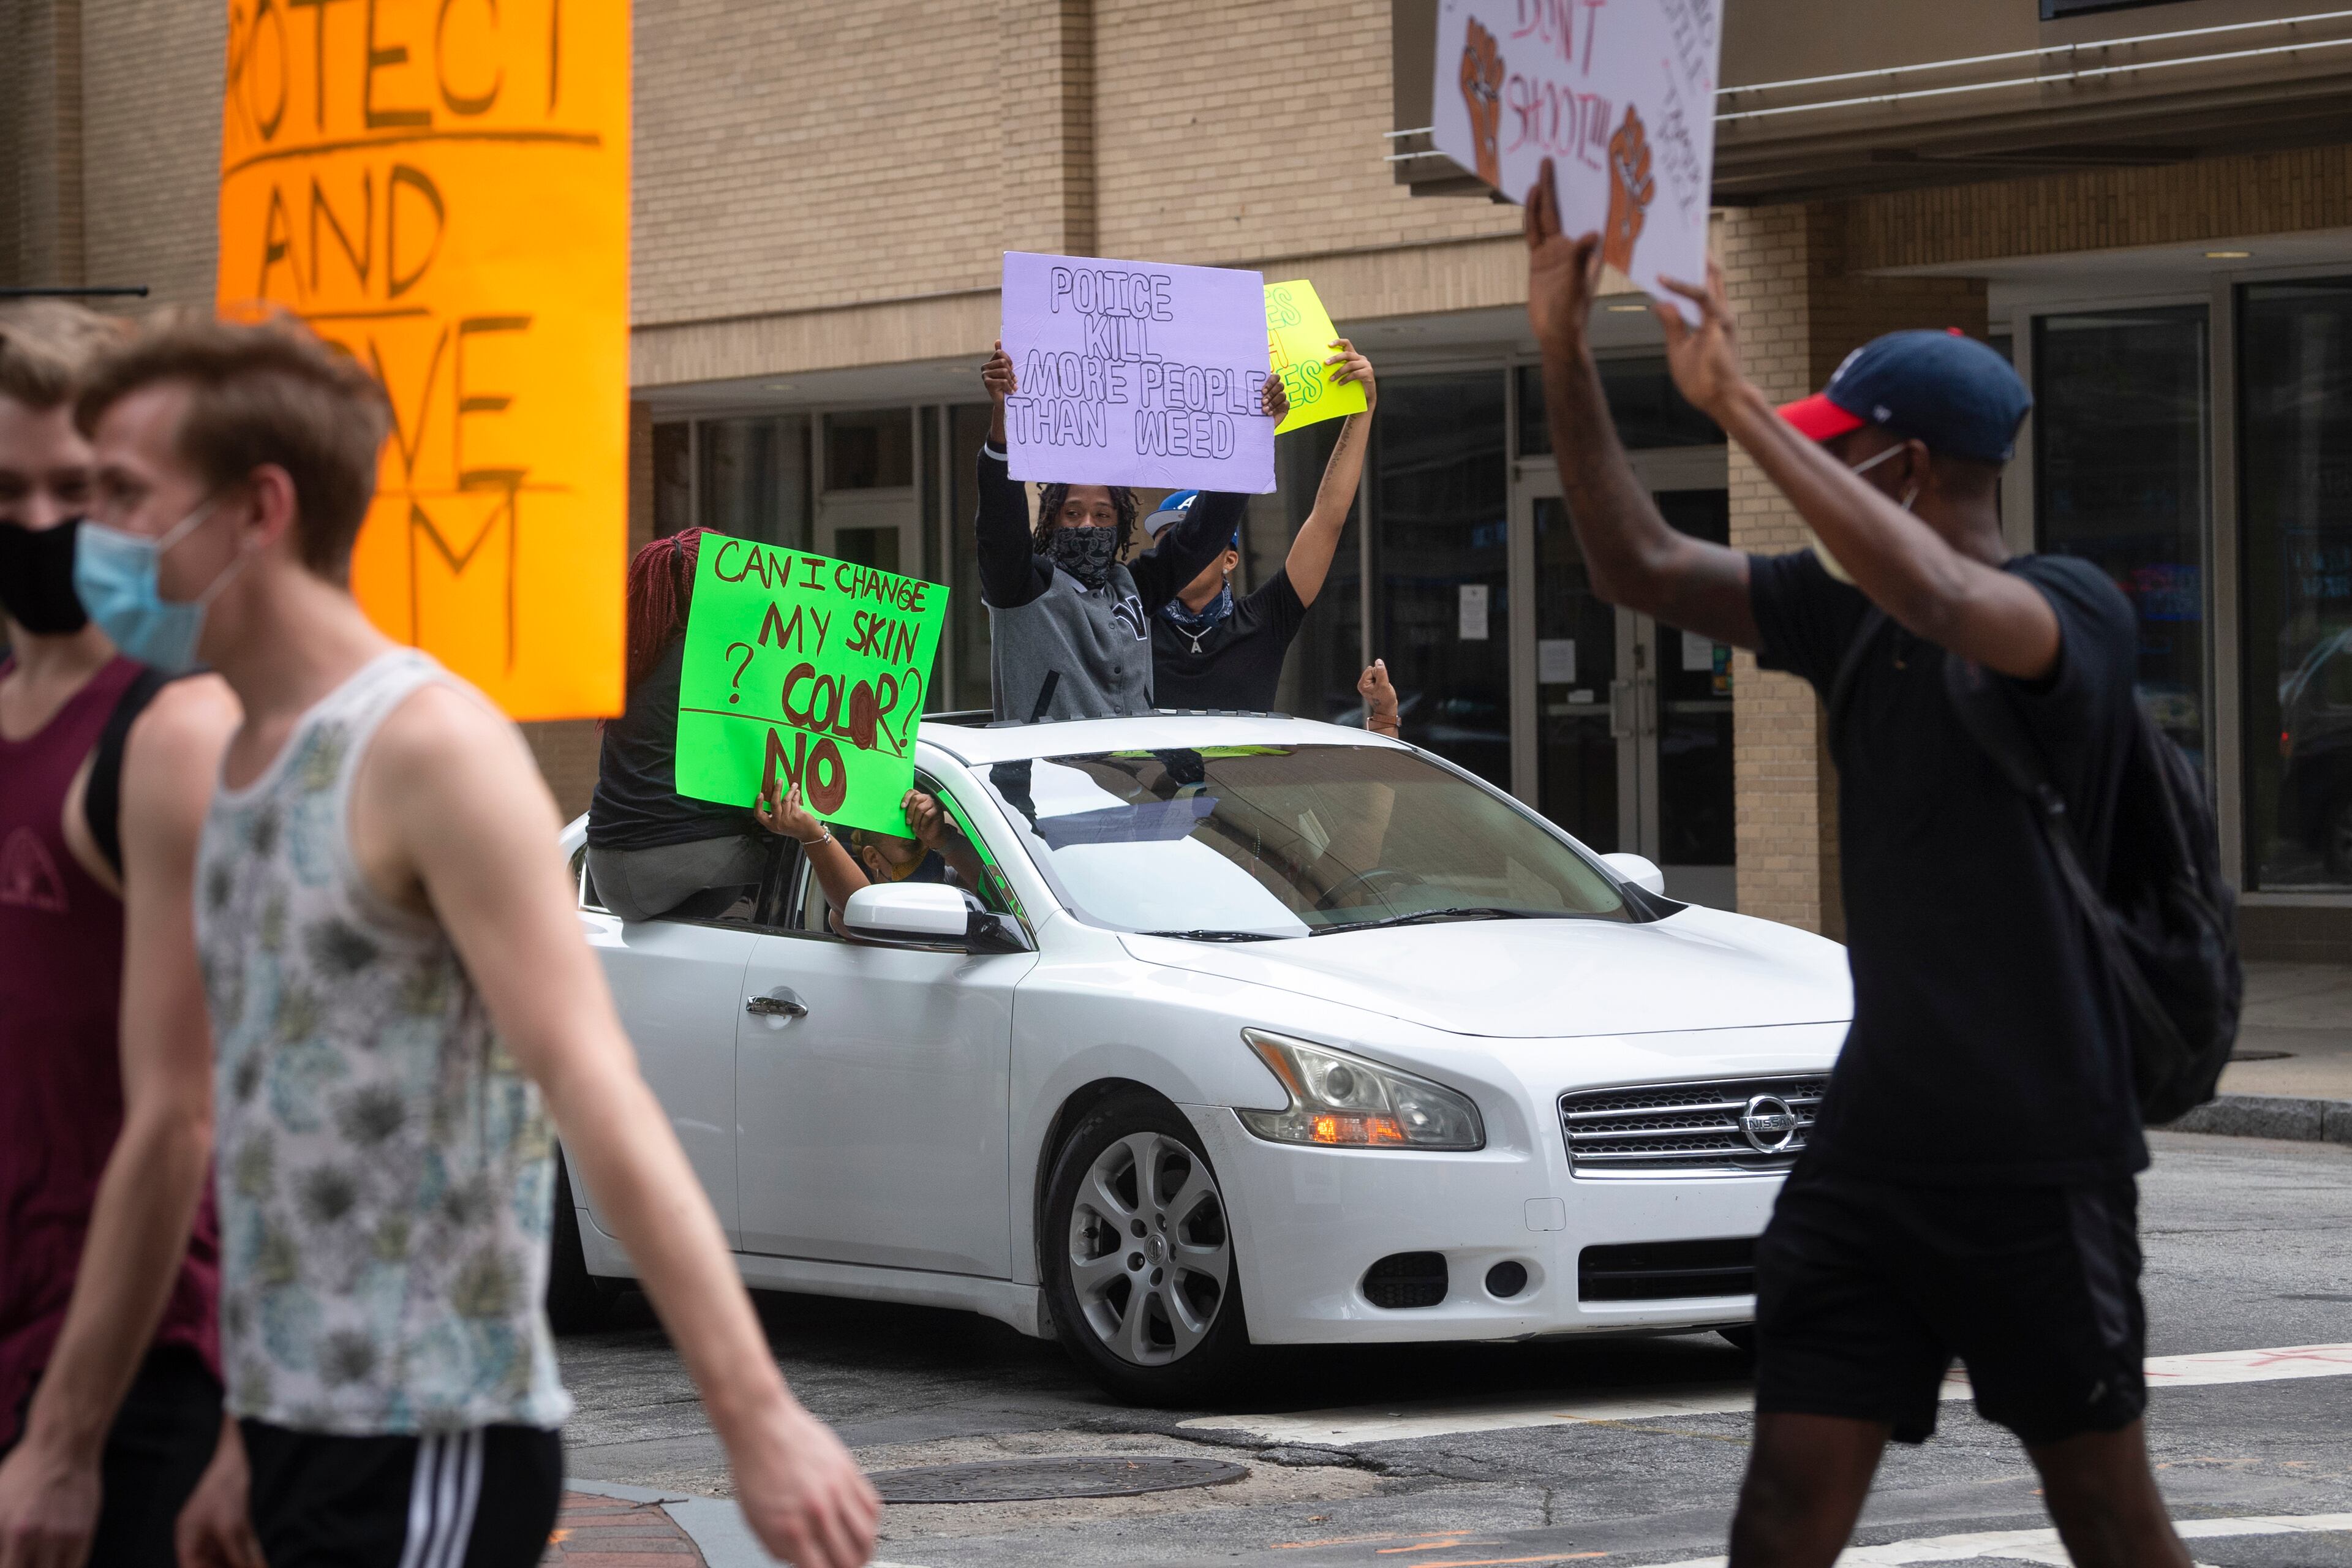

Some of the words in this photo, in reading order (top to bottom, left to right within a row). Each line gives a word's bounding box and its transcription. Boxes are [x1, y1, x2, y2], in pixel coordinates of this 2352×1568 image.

[256, 160, 448, 307] AND
[1084, 314, 1163, 363] KILL
[1022, 349, 1128, 404] MORE
[1140, 362, 1269, 417] PEOPLE
[1006, 396, 1107, 448] THAN
[1135, 409, 1235, 460] WEED
[715, 540, 792, 589] CAN
[799, 557, 826, 591] I
[834, 563, 930, 612] CHANGE
[757, 601, 831, 657] MY
[845, 610, 921, 666] SKIN
[761, 727, 848, 816] NO
[1749, 1117, 1795, 1129] NISSAN
